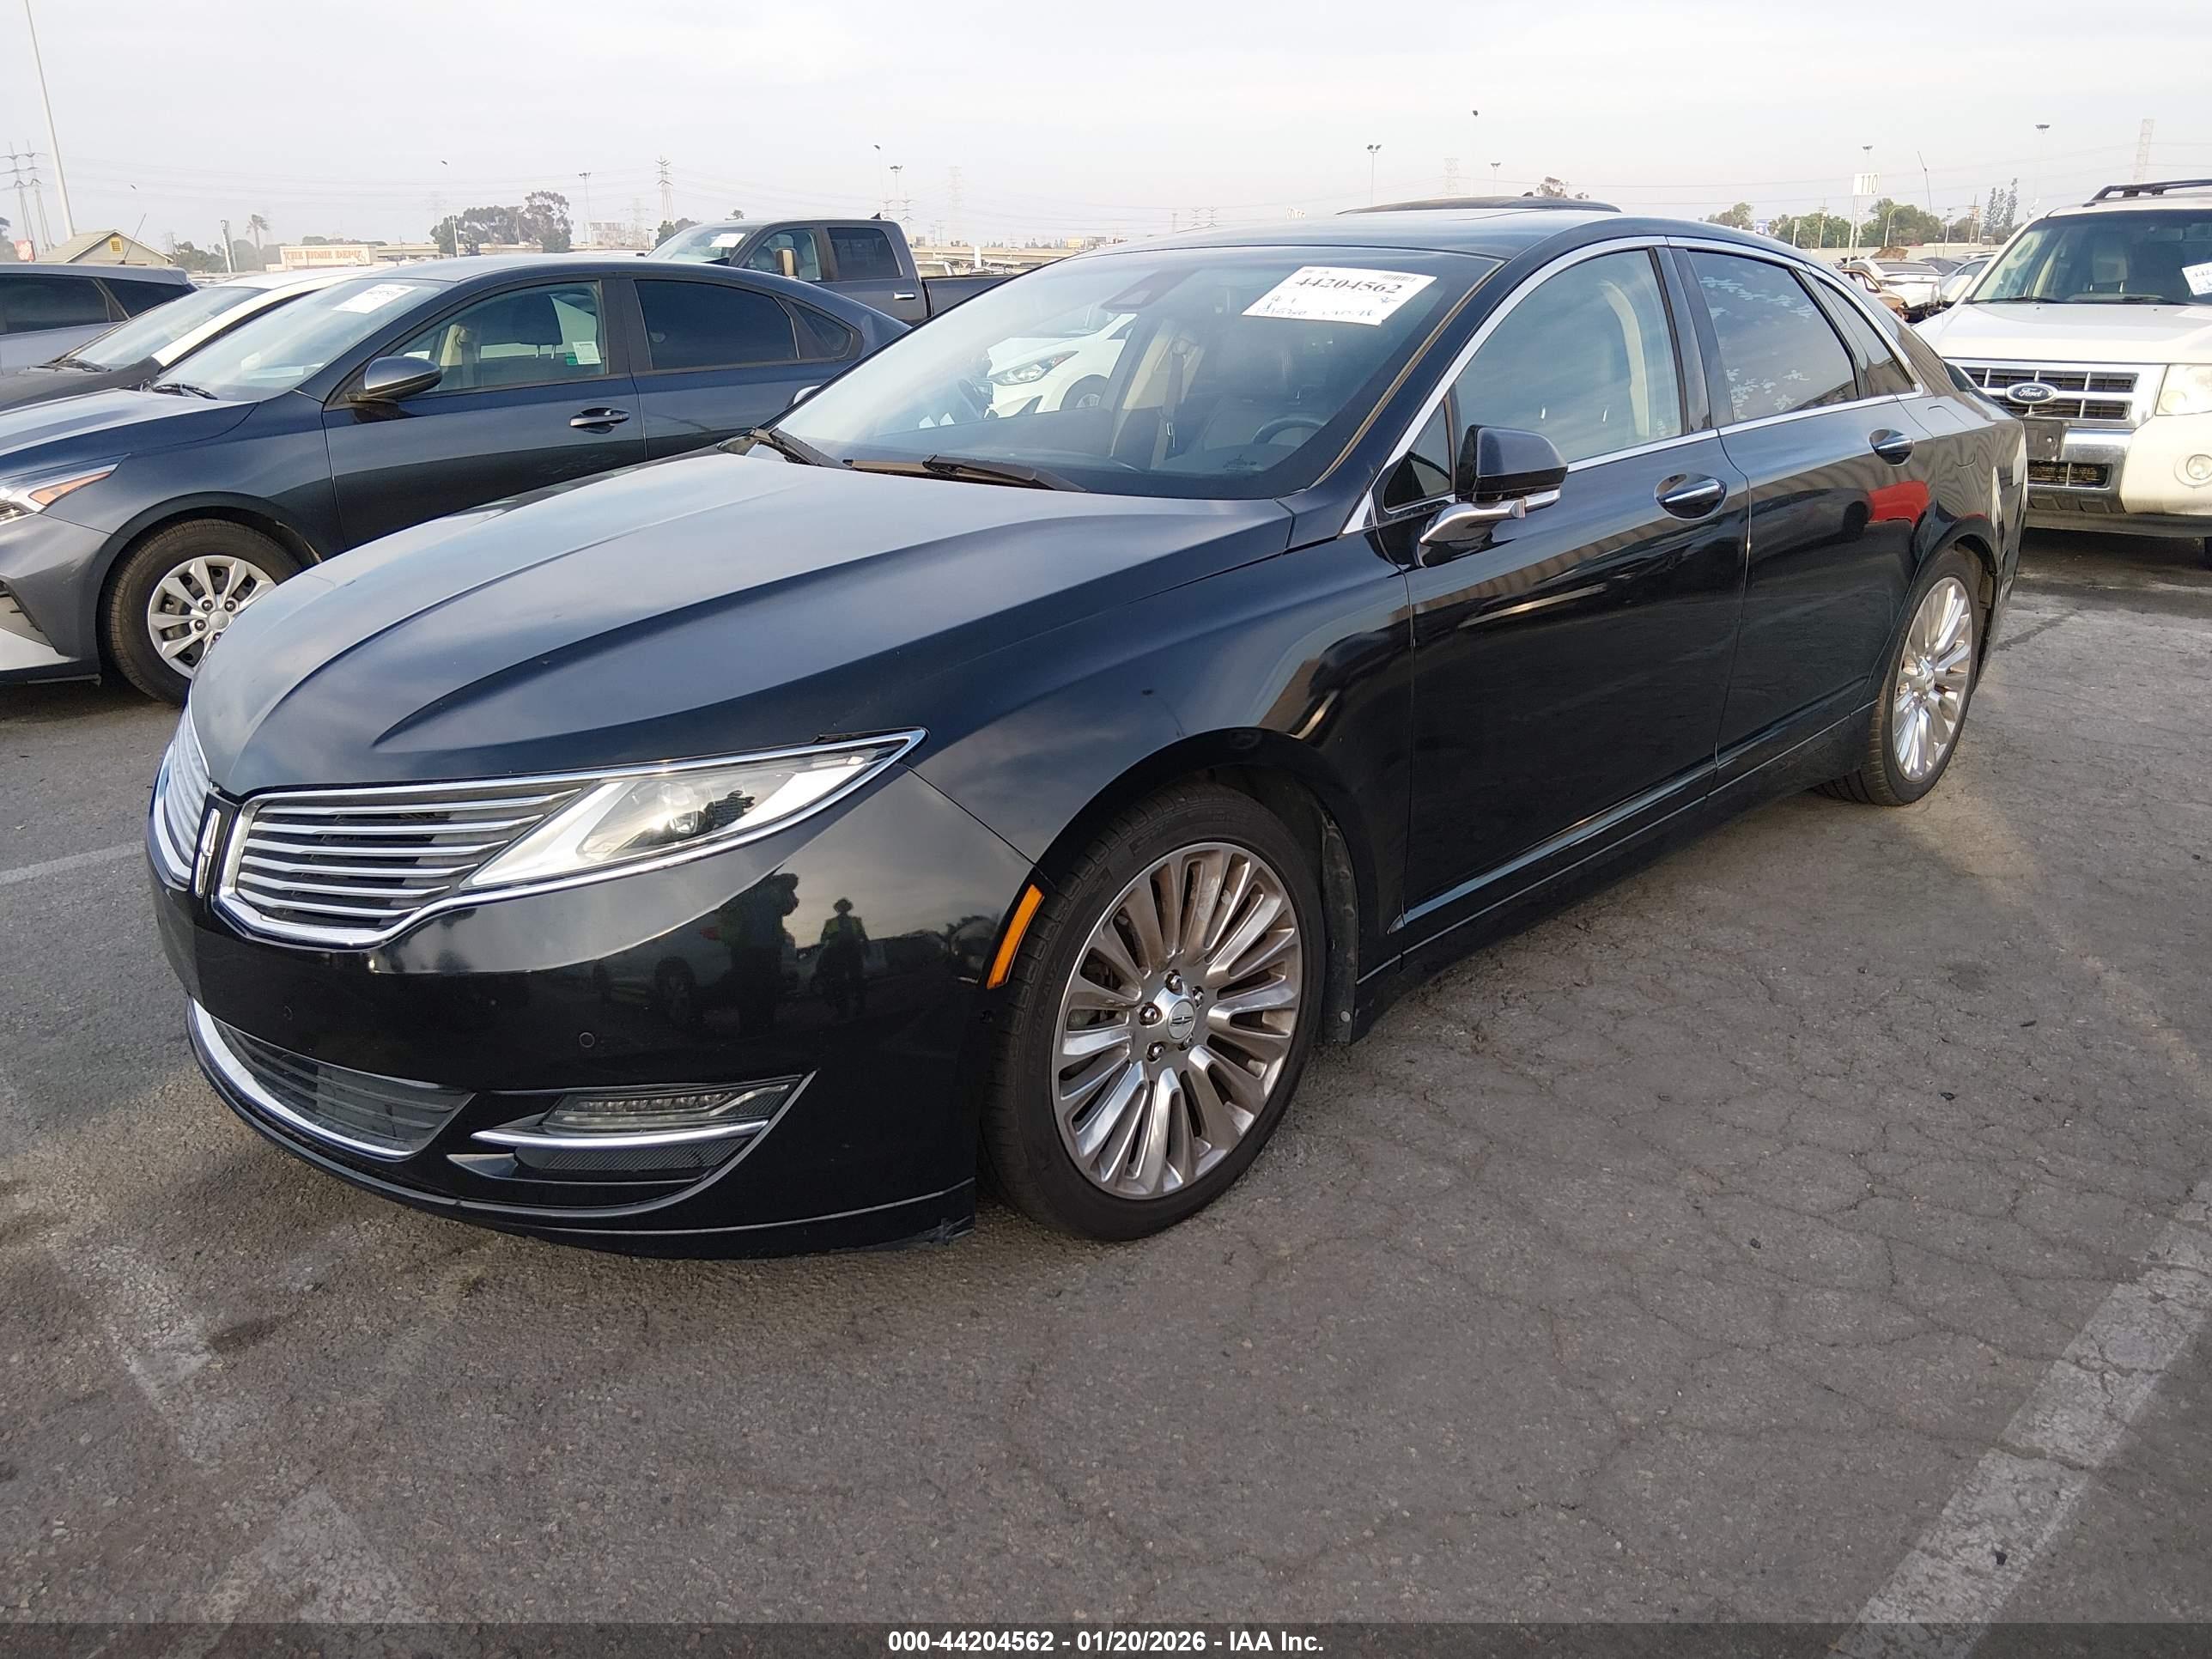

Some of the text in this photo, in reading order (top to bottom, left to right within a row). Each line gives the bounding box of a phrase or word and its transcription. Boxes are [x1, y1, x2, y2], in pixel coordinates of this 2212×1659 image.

[1861, 173, 1879, 194] 110
[1295, 277, 1402, 294] 44204562
[2018, 386, 2043, 398] Ford
